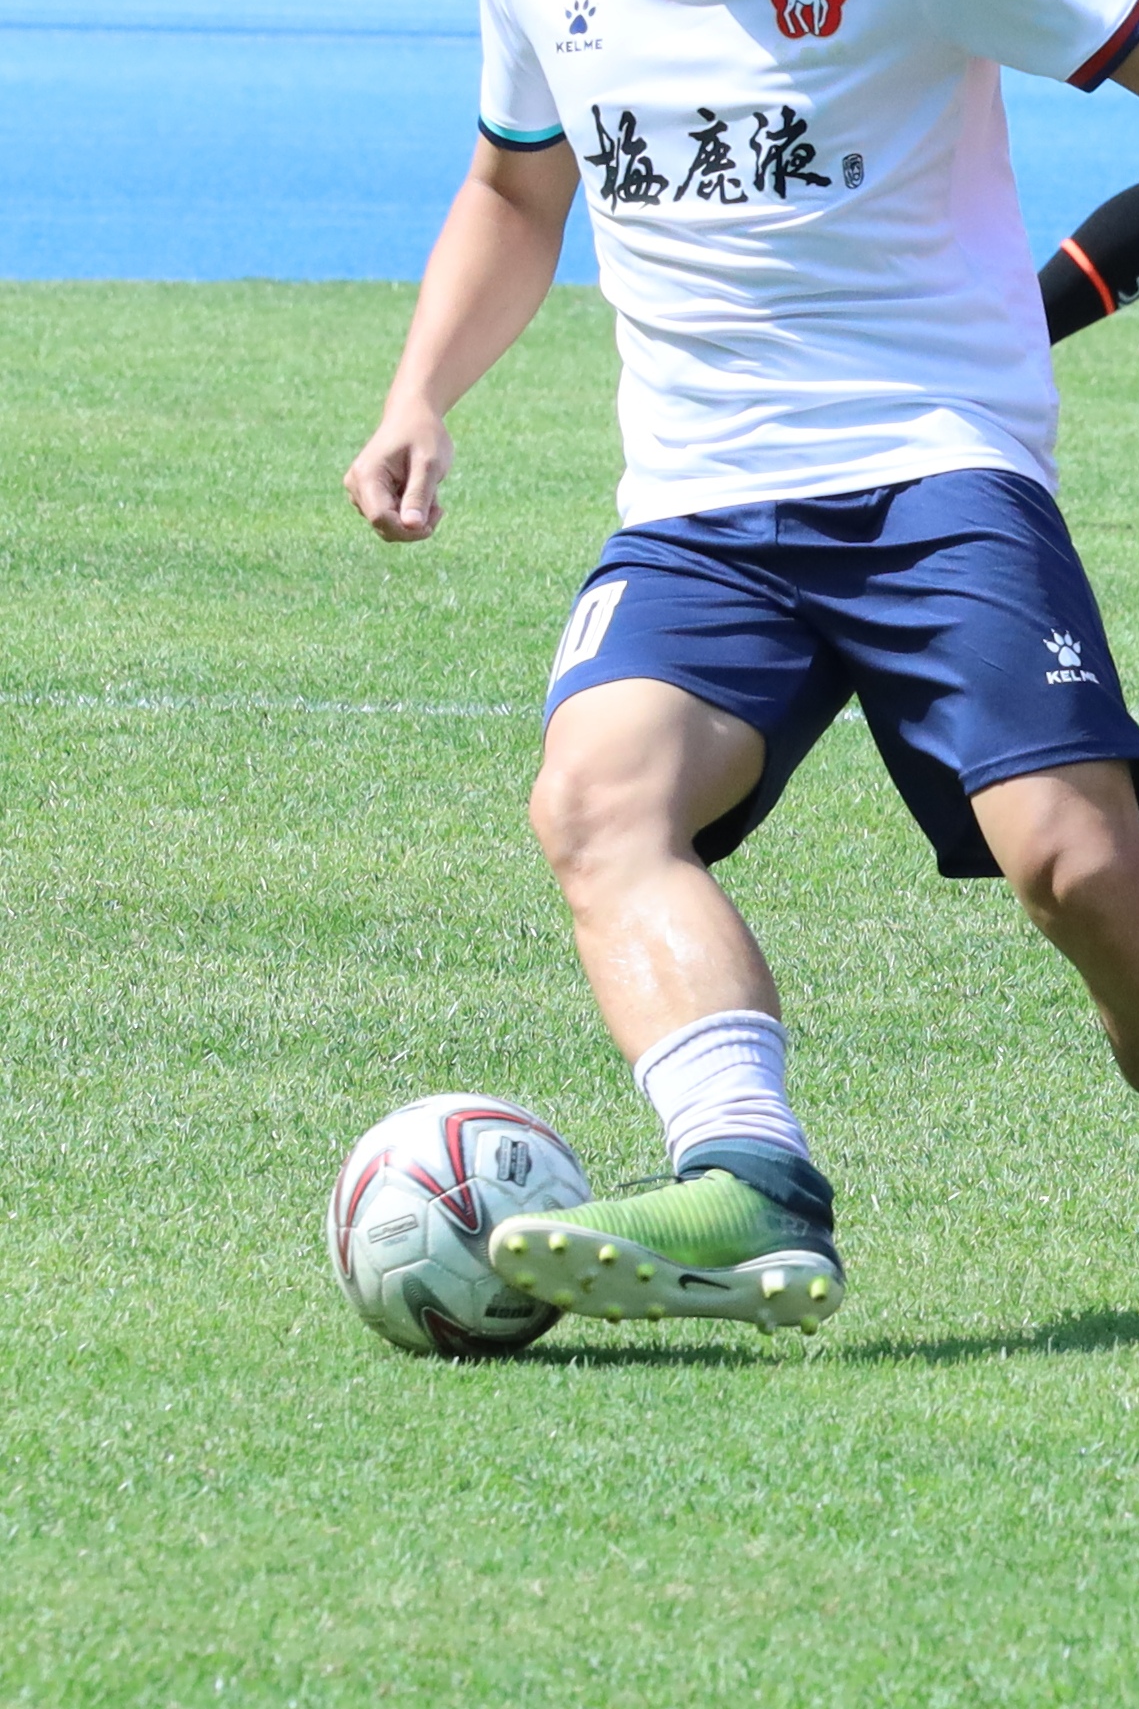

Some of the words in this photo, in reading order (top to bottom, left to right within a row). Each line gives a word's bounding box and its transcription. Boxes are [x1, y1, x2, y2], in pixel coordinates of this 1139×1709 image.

[555, 38, 603, 53] KELME
[584, 104, 832, 214] 梅鹿液
[1045, 669, 1100, 685] KELM
